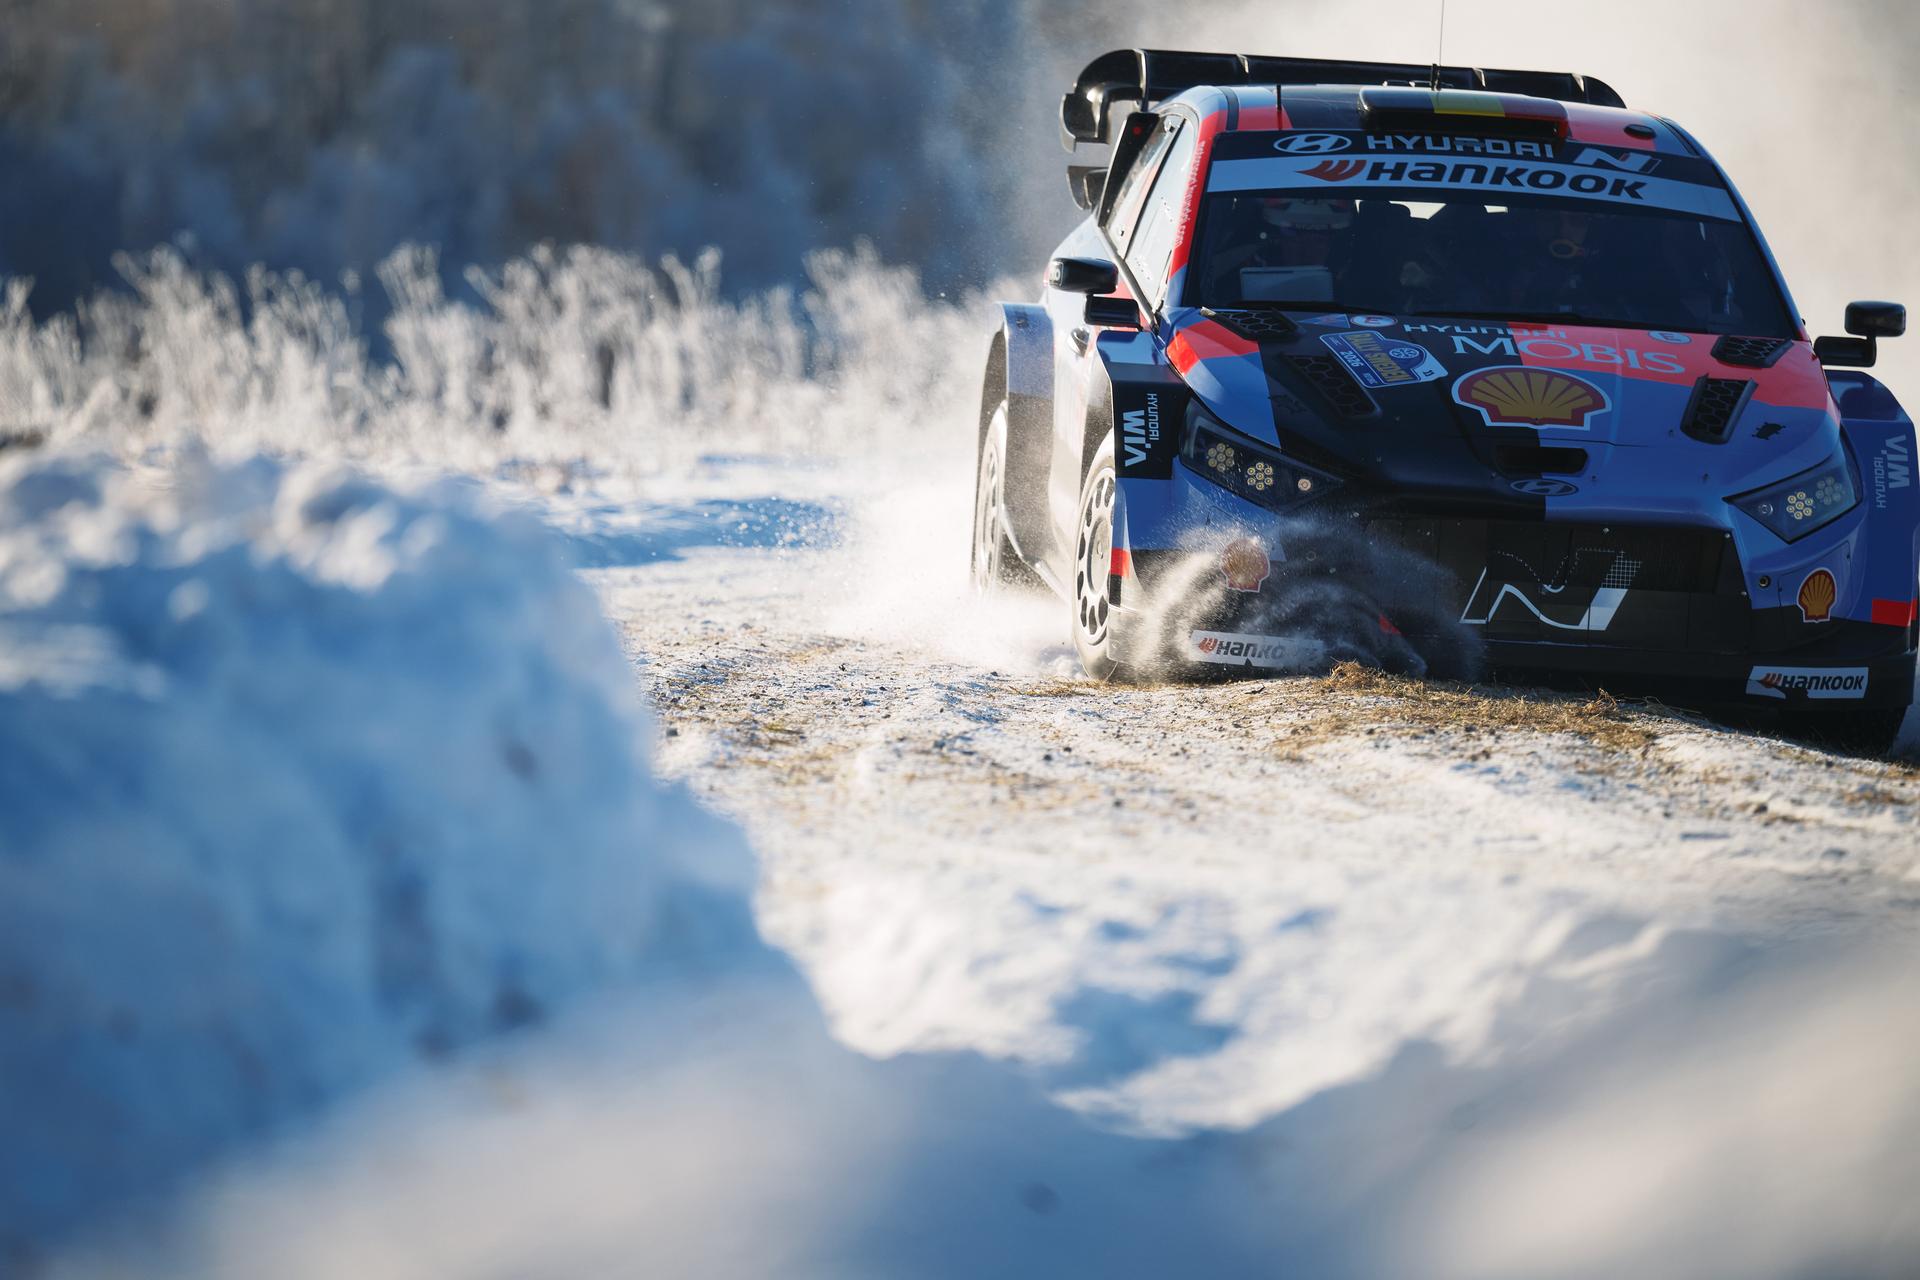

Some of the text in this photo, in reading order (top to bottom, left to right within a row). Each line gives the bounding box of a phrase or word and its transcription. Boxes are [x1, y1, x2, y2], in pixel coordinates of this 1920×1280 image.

[1365, 134, 1554, 159] HYUNDAI
[1402, 323, 1567, 339] HYUNDAI
[1339, 350, 1364, 368] 2026
[1450, 334, 1686, 374] MOBIS
[1146, 393, 1160, 441] HYUNDAI
[1873, 456, 1888, 509] HYUNDAI
